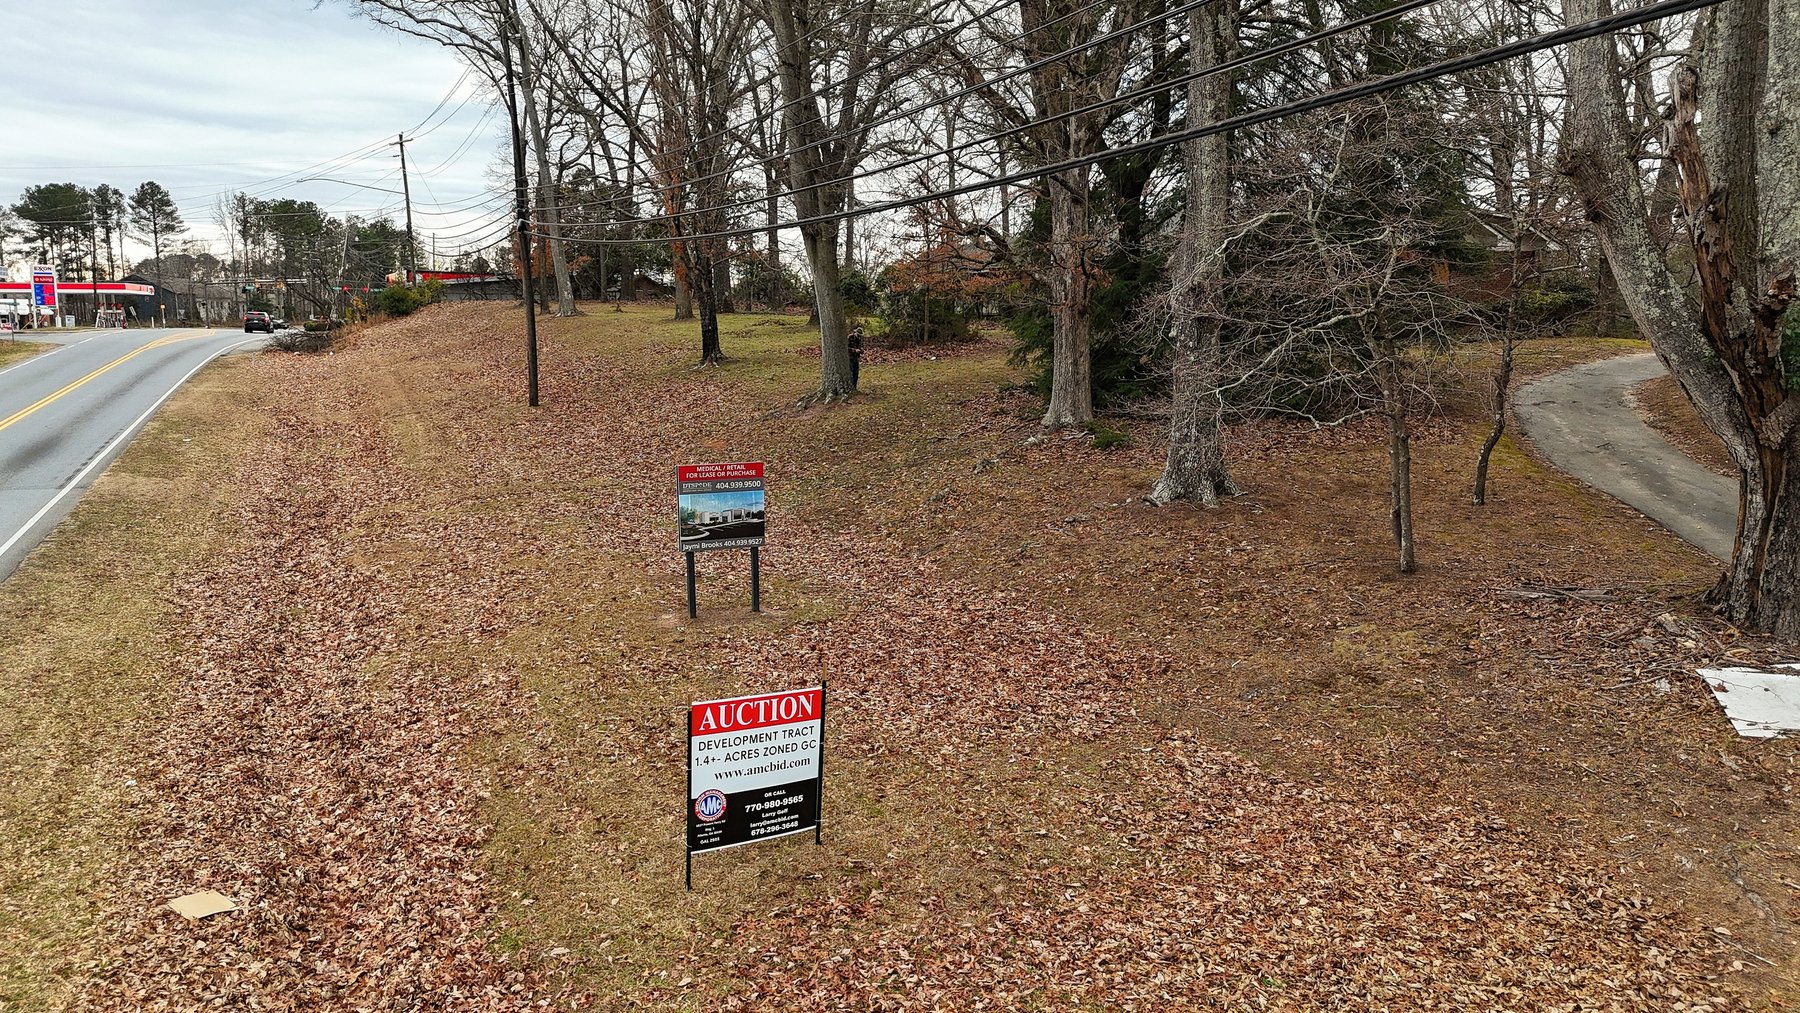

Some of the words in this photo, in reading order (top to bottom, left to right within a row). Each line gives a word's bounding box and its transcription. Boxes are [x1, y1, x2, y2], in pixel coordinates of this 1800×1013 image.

[715, 480, 761, 489] 404.939.9500
[682, 543, 700, 551] Jaymi
[701, 541, 723, 549] Brooks
[723, 538, 763, 547] 404.939.9527
[699, 694, 815, 731] AUCTION
[698, 731, 779, 752] DEVELOPMENT
[782, 725, 815, 739] TRACT
[694, 755, 721, 767] 1.4+-
[724, 748, 760, 763] ACRES
[763, 743, 798, 757] ZONED
[801, 739, 817, 750] GC
[714, 757, 811, 780] www.amcbid.com
[700, 796, 722, 815] AMC
[745, 794, 804, 813] 770-980-9565
[751, 820, 799, 836] 678-296-3648
